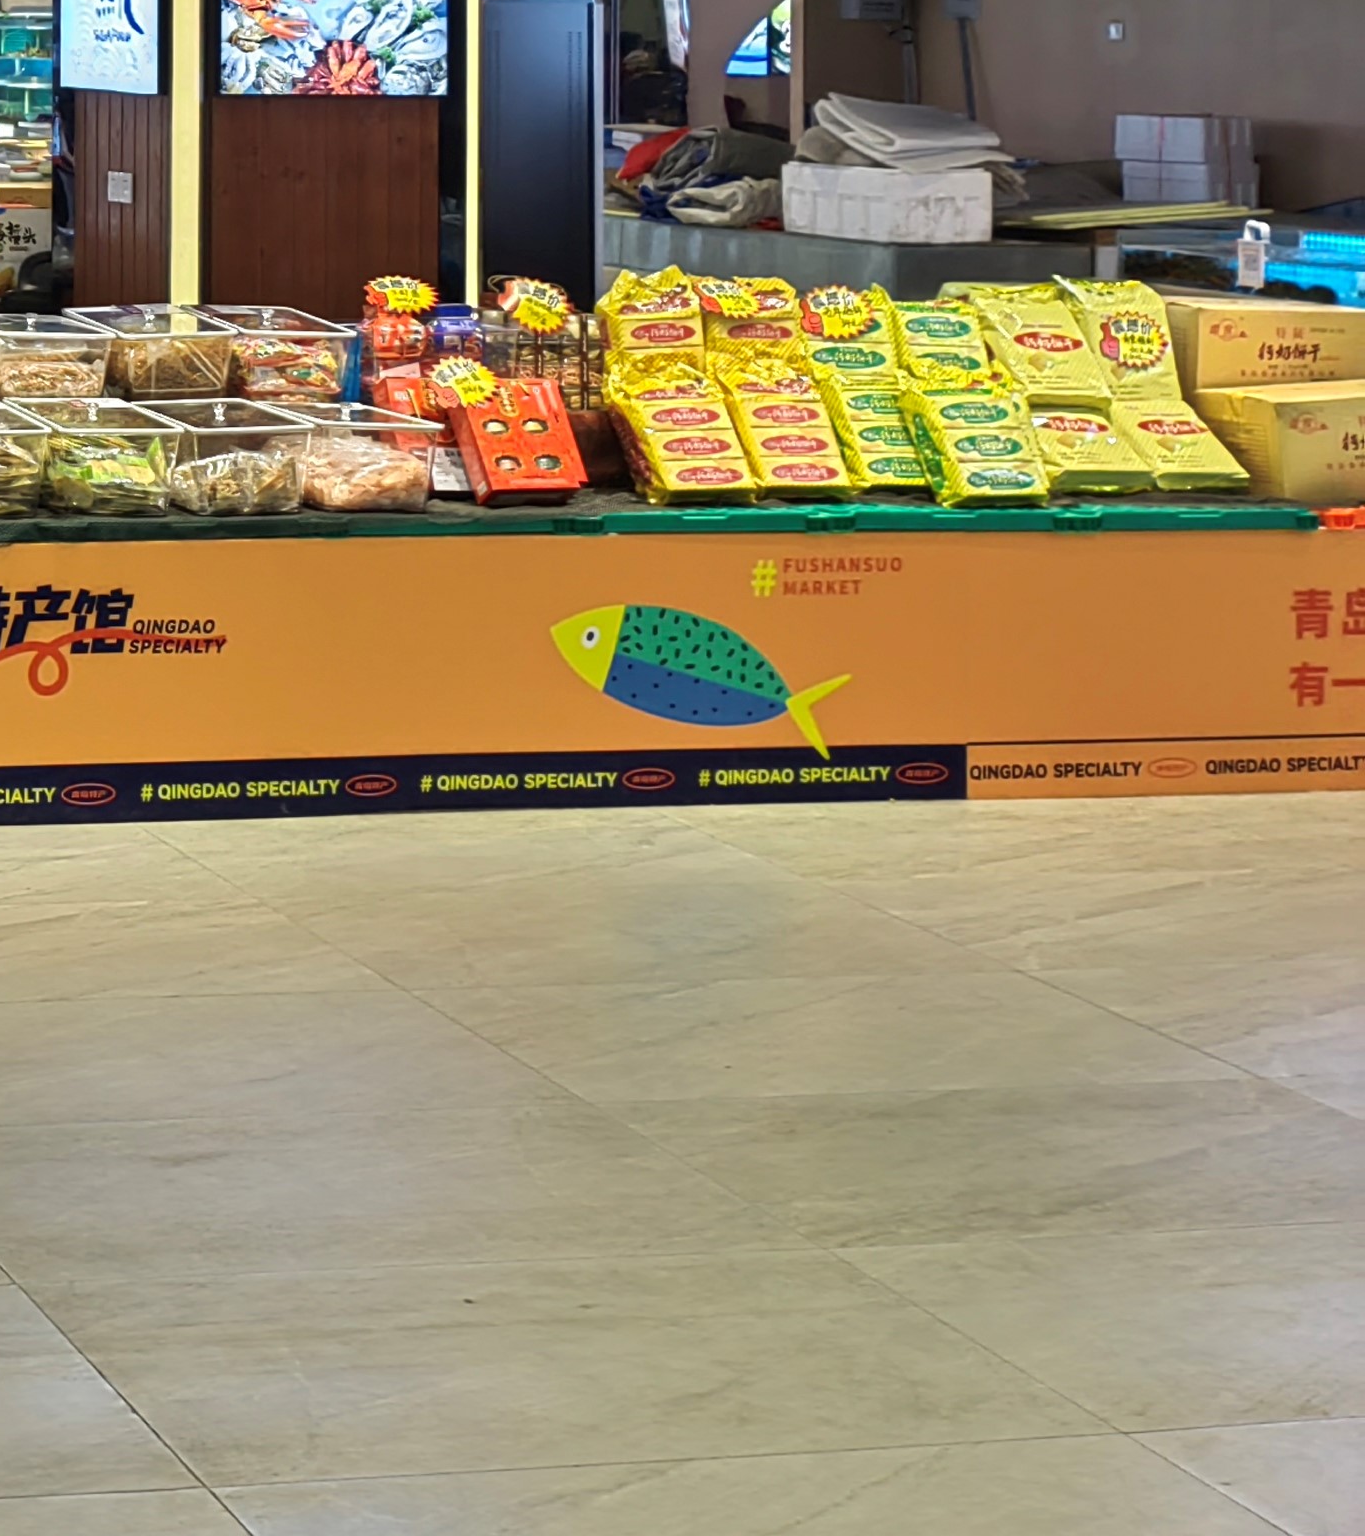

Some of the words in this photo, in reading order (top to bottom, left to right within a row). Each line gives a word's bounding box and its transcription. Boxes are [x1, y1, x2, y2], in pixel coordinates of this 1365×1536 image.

[782, 557, 903, 574] FUSHANSUO
[782, 579, 863, 596] MARKET
[133, 619, 216, 635] QINGDAO
[129, 638, 227, 654] SPECIALTY
[714, 767, 795, 786] QINGDAO
[799, 764, 891, 783] SPECIALTY
[969, 763, 1048, 781] QINGDAO
[1052, 760, 1142, 779] SPECIALTY
[1205, 757, 1282, 775] QINGDAO
[157, 781, 241, 800] QINGDAO
[245, 778, 341, 797] SPECIALTY
[436, 772, 519, 791] QINGDAO
[523, 771, 619, 789] SPECIALTY
